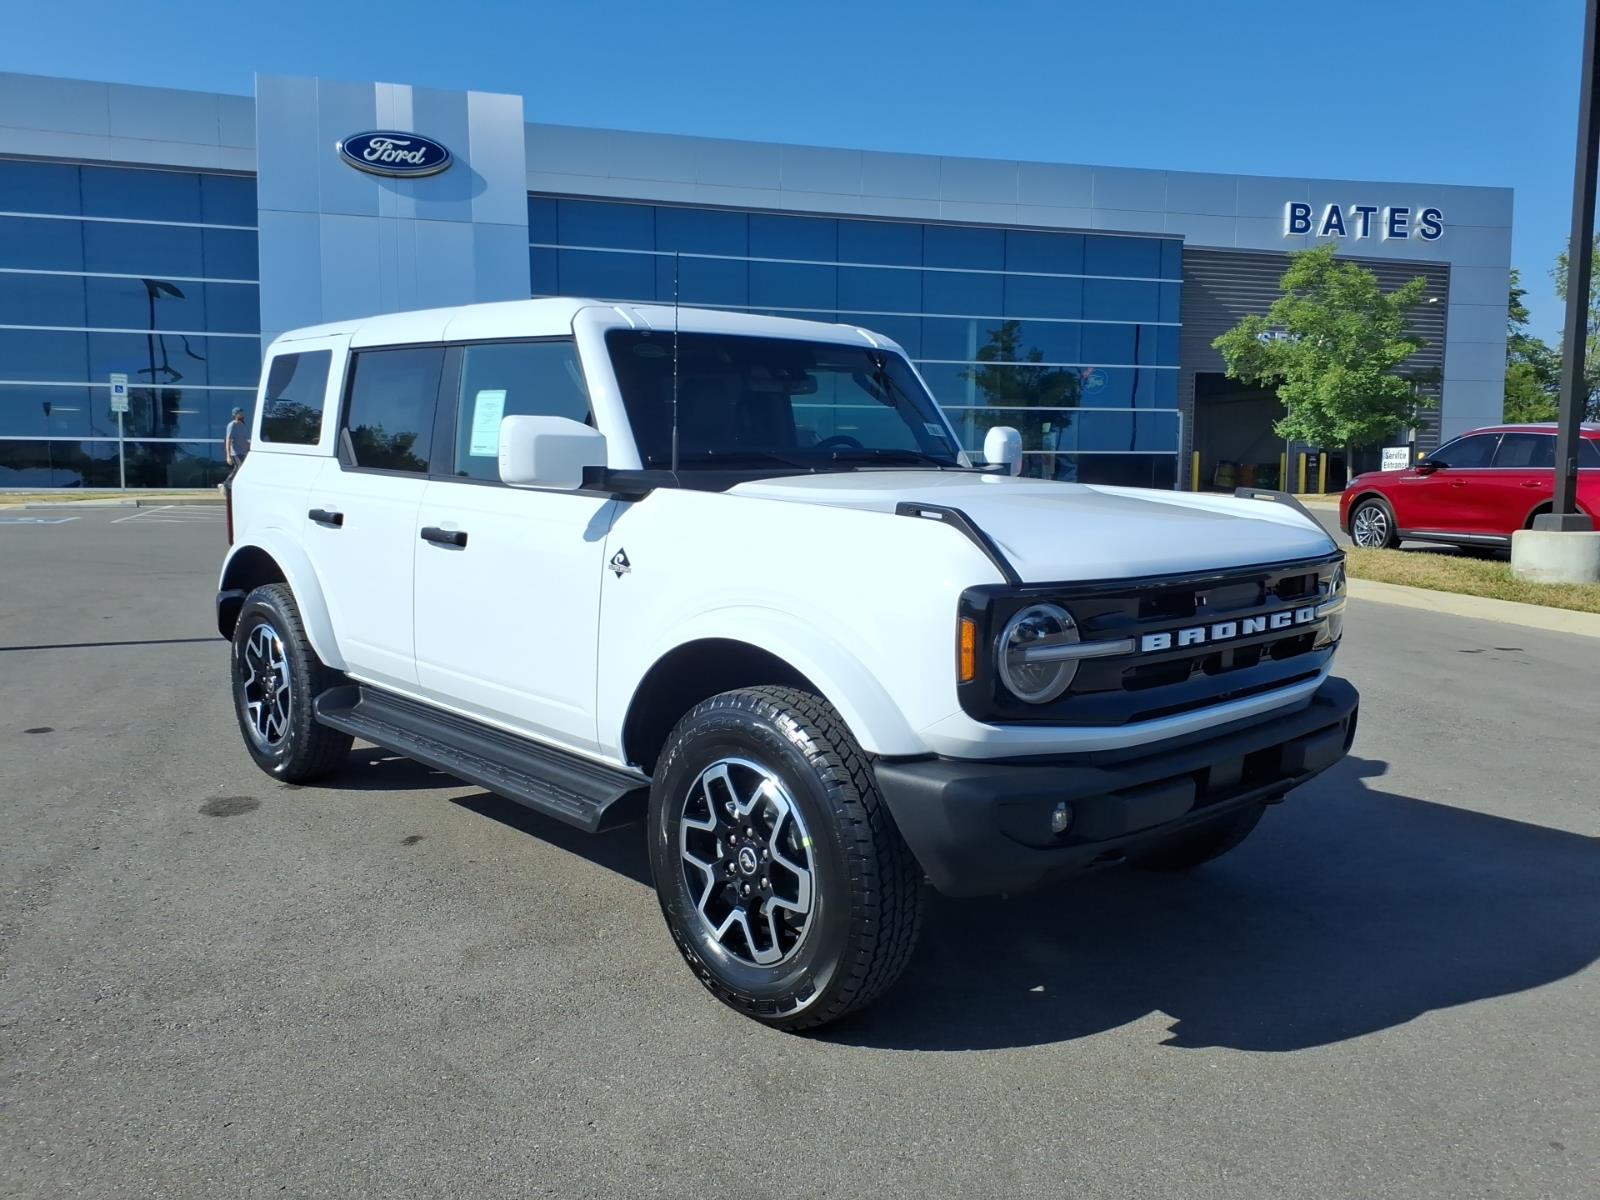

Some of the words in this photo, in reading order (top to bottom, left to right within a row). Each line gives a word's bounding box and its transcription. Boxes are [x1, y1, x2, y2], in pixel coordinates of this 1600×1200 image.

[363, 137, 427, 164] Ford
[1284, 201, 1444, 241] BATES
[1385, 451, 1407, 460] Service
[1141, 606, 1315, 652] BRONCO
